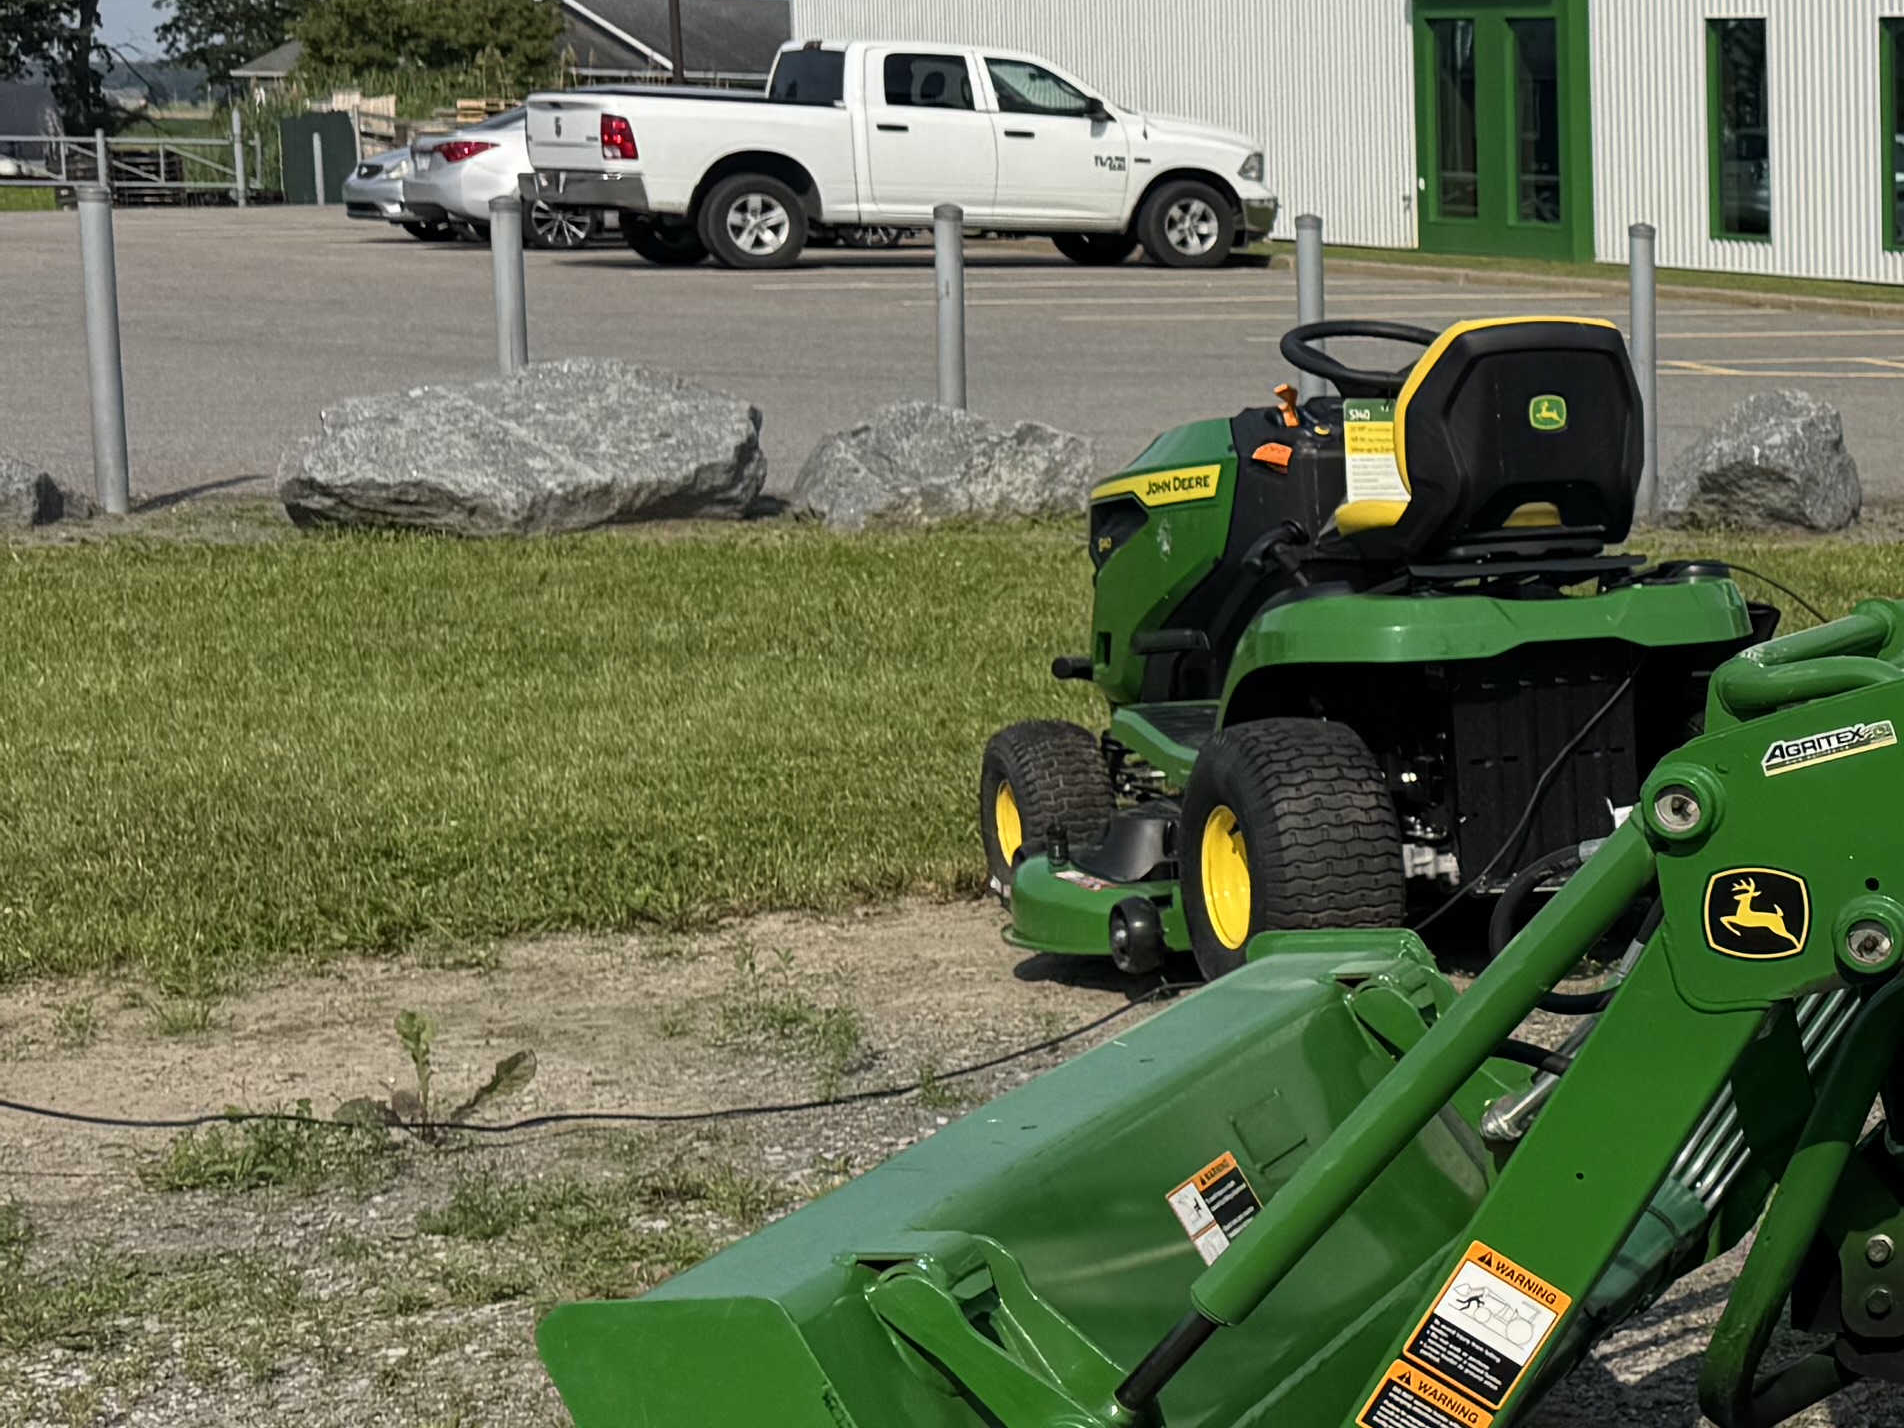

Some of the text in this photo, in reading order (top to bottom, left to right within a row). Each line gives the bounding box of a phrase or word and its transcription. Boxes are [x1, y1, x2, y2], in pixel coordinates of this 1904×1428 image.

[1146, 475, 1210, 496] JOHN DEERE
[1765, 727, 1865, 763] AGRITEX
[1495, 1261, 1557, 1306] WARNING
[1418, 1380, 1479, 1424] WARNING
